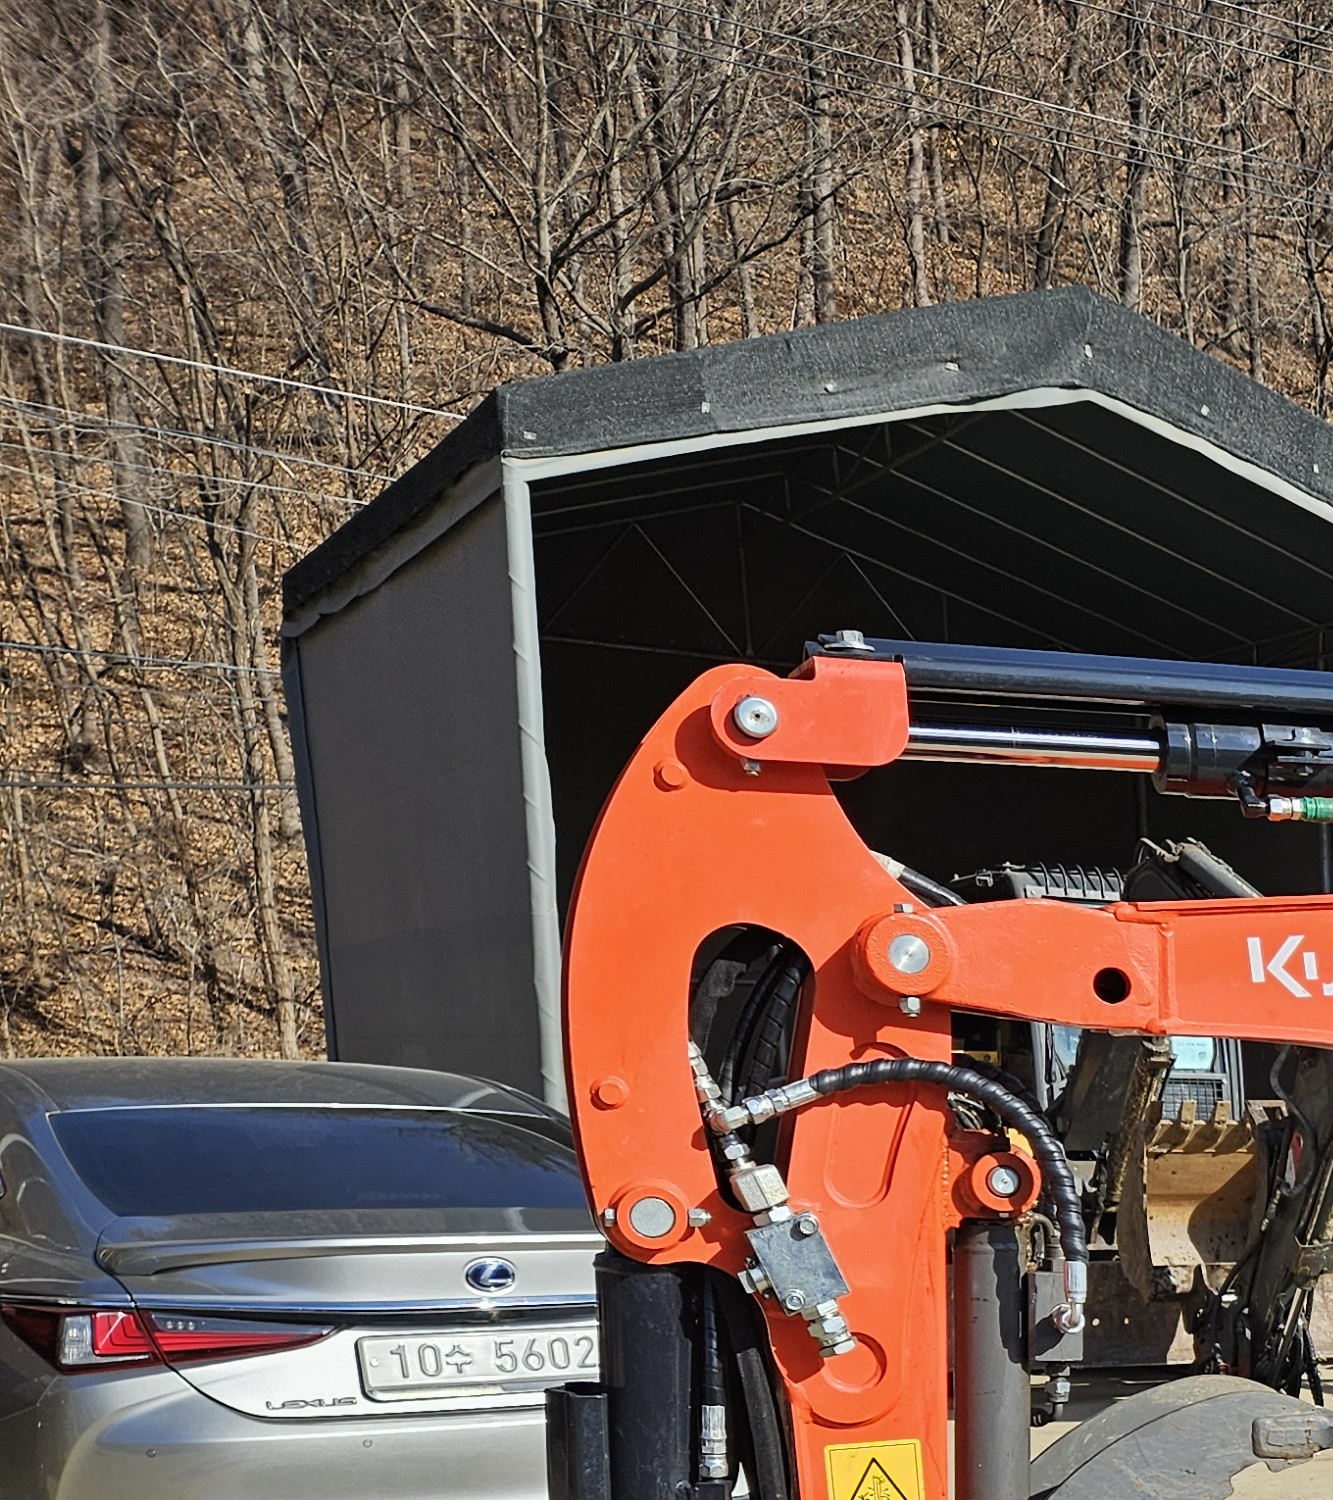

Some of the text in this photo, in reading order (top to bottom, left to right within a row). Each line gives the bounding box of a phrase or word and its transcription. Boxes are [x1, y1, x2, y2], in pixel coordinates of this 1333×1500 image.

[390, 1336, 597, 1379] 10수 5602
[265, 1396, 357, 1410] LEXUS
